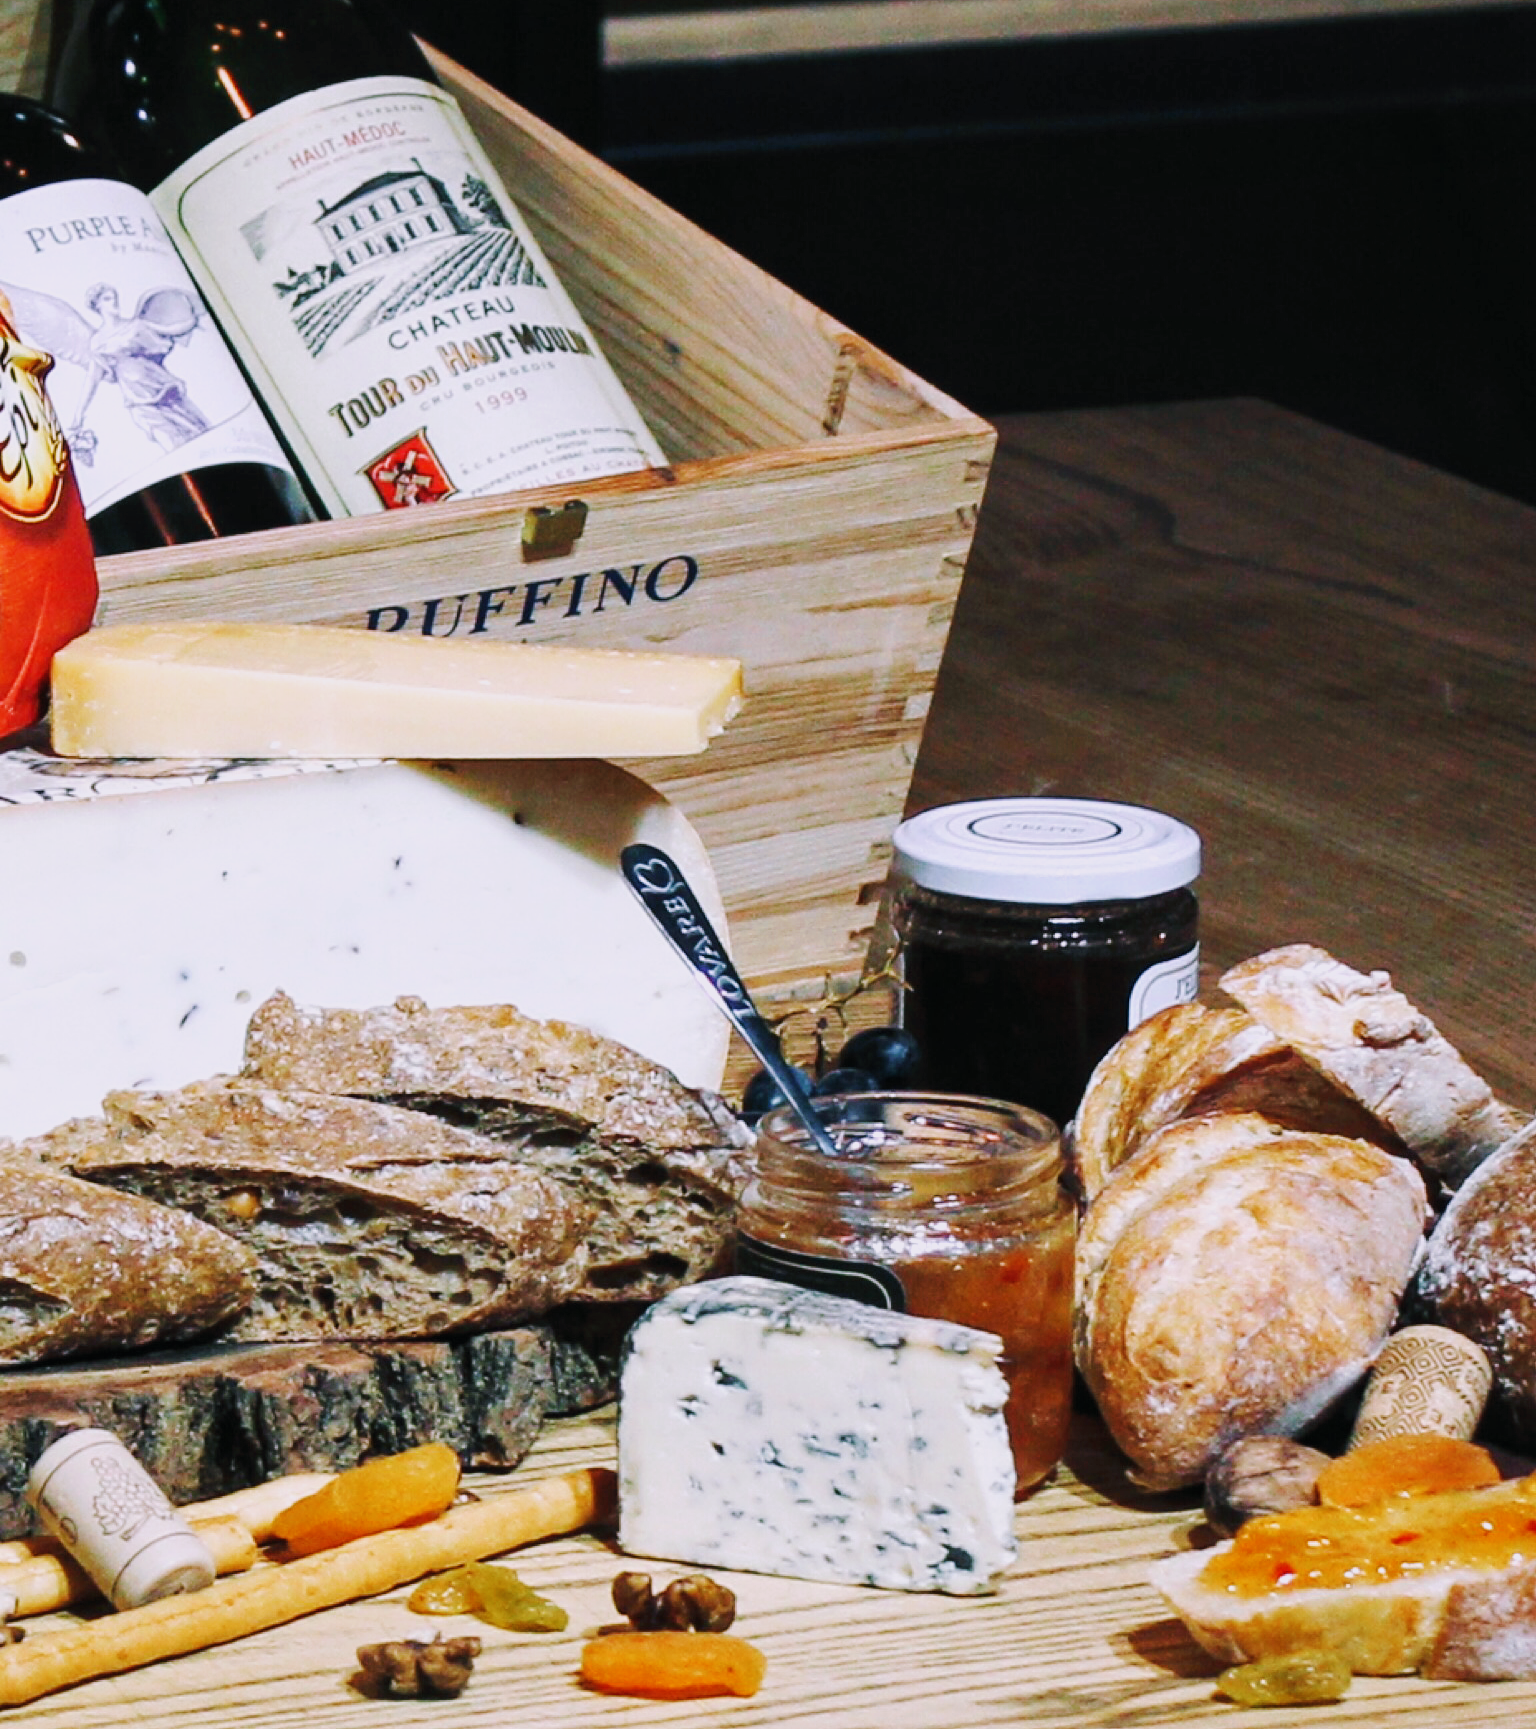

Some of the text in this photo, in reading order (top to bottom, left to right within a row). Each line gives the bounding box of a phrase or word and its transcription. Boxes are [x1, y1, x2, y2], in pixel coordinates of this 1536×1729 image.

[25, 214, 137, 254] PURPLE
[387, 294, 517, 351] CHATEAU
[328, 376, 405, 438] TOUR
[474, 386, 529, 415] 1999
